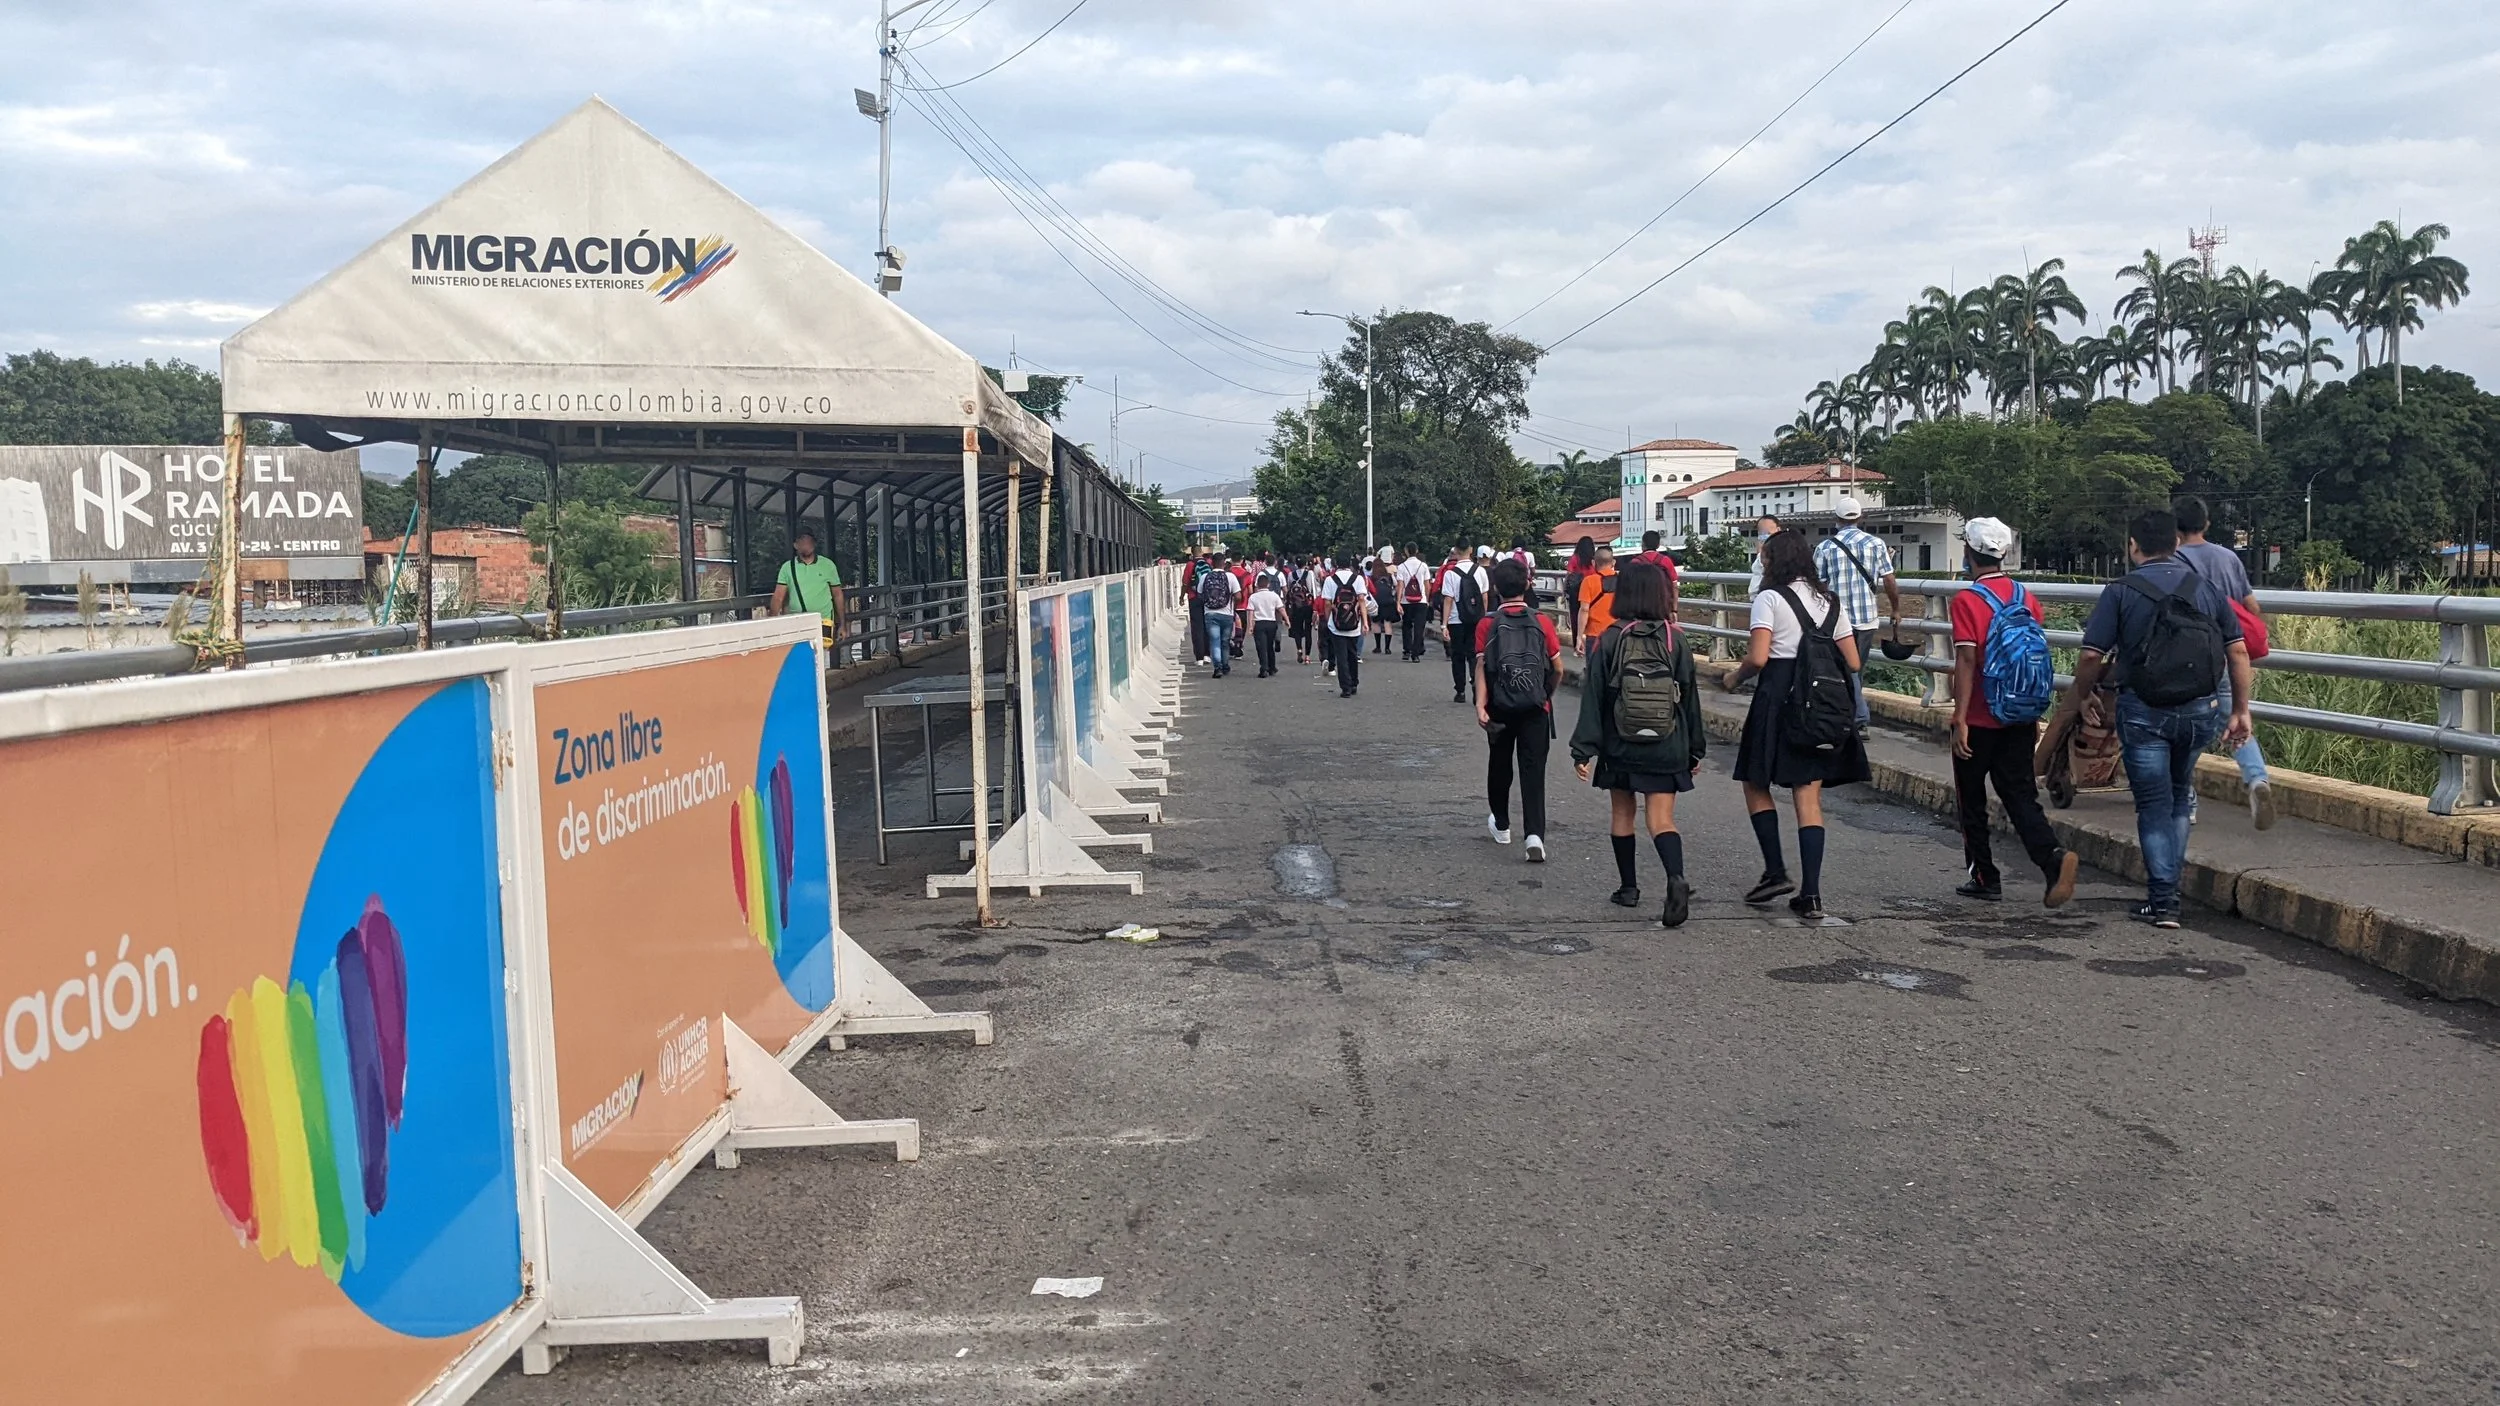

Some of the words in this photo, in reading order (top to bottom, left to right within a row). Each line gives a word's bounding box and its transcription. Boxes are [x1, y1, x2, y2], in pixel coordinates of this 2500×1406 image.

[411, 229, 696, 274] MIGRACIÓN
[411, 275, 480, 287] MINISTERIO
[483, 277, 498, 287] DE
[501, 278, 572, 289] RELACIONES
[575, 279, 644, 290] EXTERIORES
[366, 387, 832, 419] www.migracioncolombia.gov.co
[164, 454, 294, 482] HOEL
[170, 542, 194, 553] AV.
[197, 541, 207, 552] 3
[283, 540, 340, 551] CENTRO
[553, 728, 615, 785] Zona
[619, 710, 662, 765] libre
[558, 800, 590, 861] de
[596, 751, 731, 845] discriminación.
[0, 934, 198, 1078] ación.
[678, 1016, 708, 1053] UNHCR
[680, 1036, 708, 1076] ACNUR
[571, 1074, 641, 1151] MIGRACIÓN
